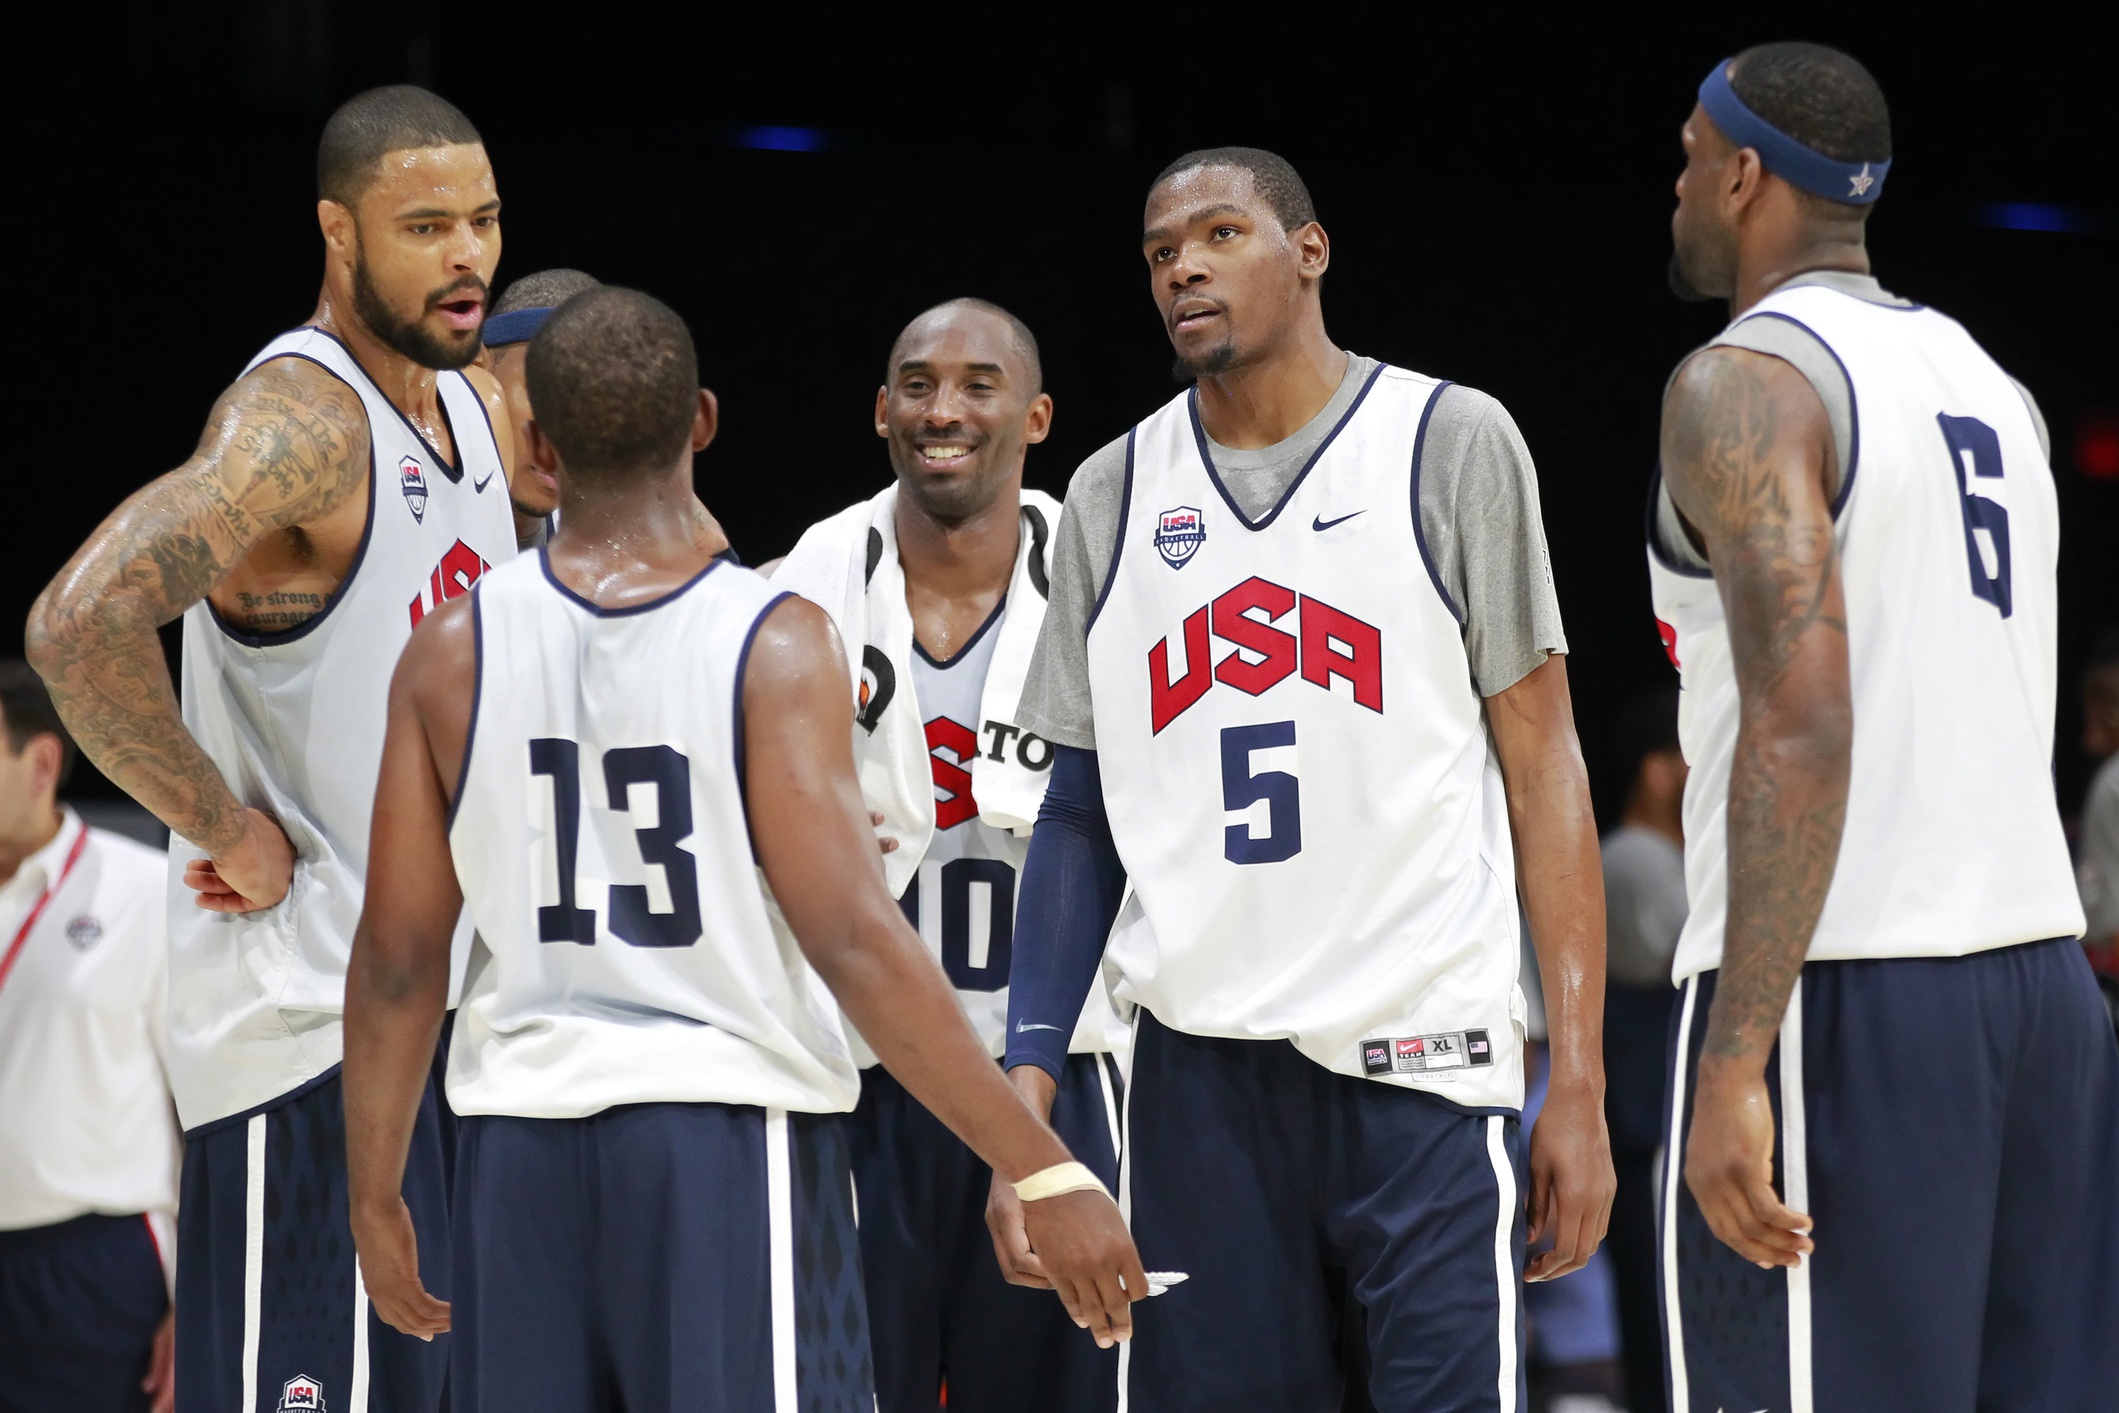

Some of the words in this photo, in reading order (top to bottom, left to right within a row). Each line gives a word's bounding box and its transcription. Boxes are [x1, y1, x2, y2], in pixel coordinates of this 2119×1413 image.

[1163, 515, 1196, 532] USA
[1935, 409, 2013, 620] 6
[266, 590, 321, 609] strong
[1148, 575, 1384, 737] USA
[1220, 720, 1302, 865] 5
[529, 737, 703, 948] 13
[1432, 1039, 1453, 1052] XL
[288, 1386, 314, 1405] USA
